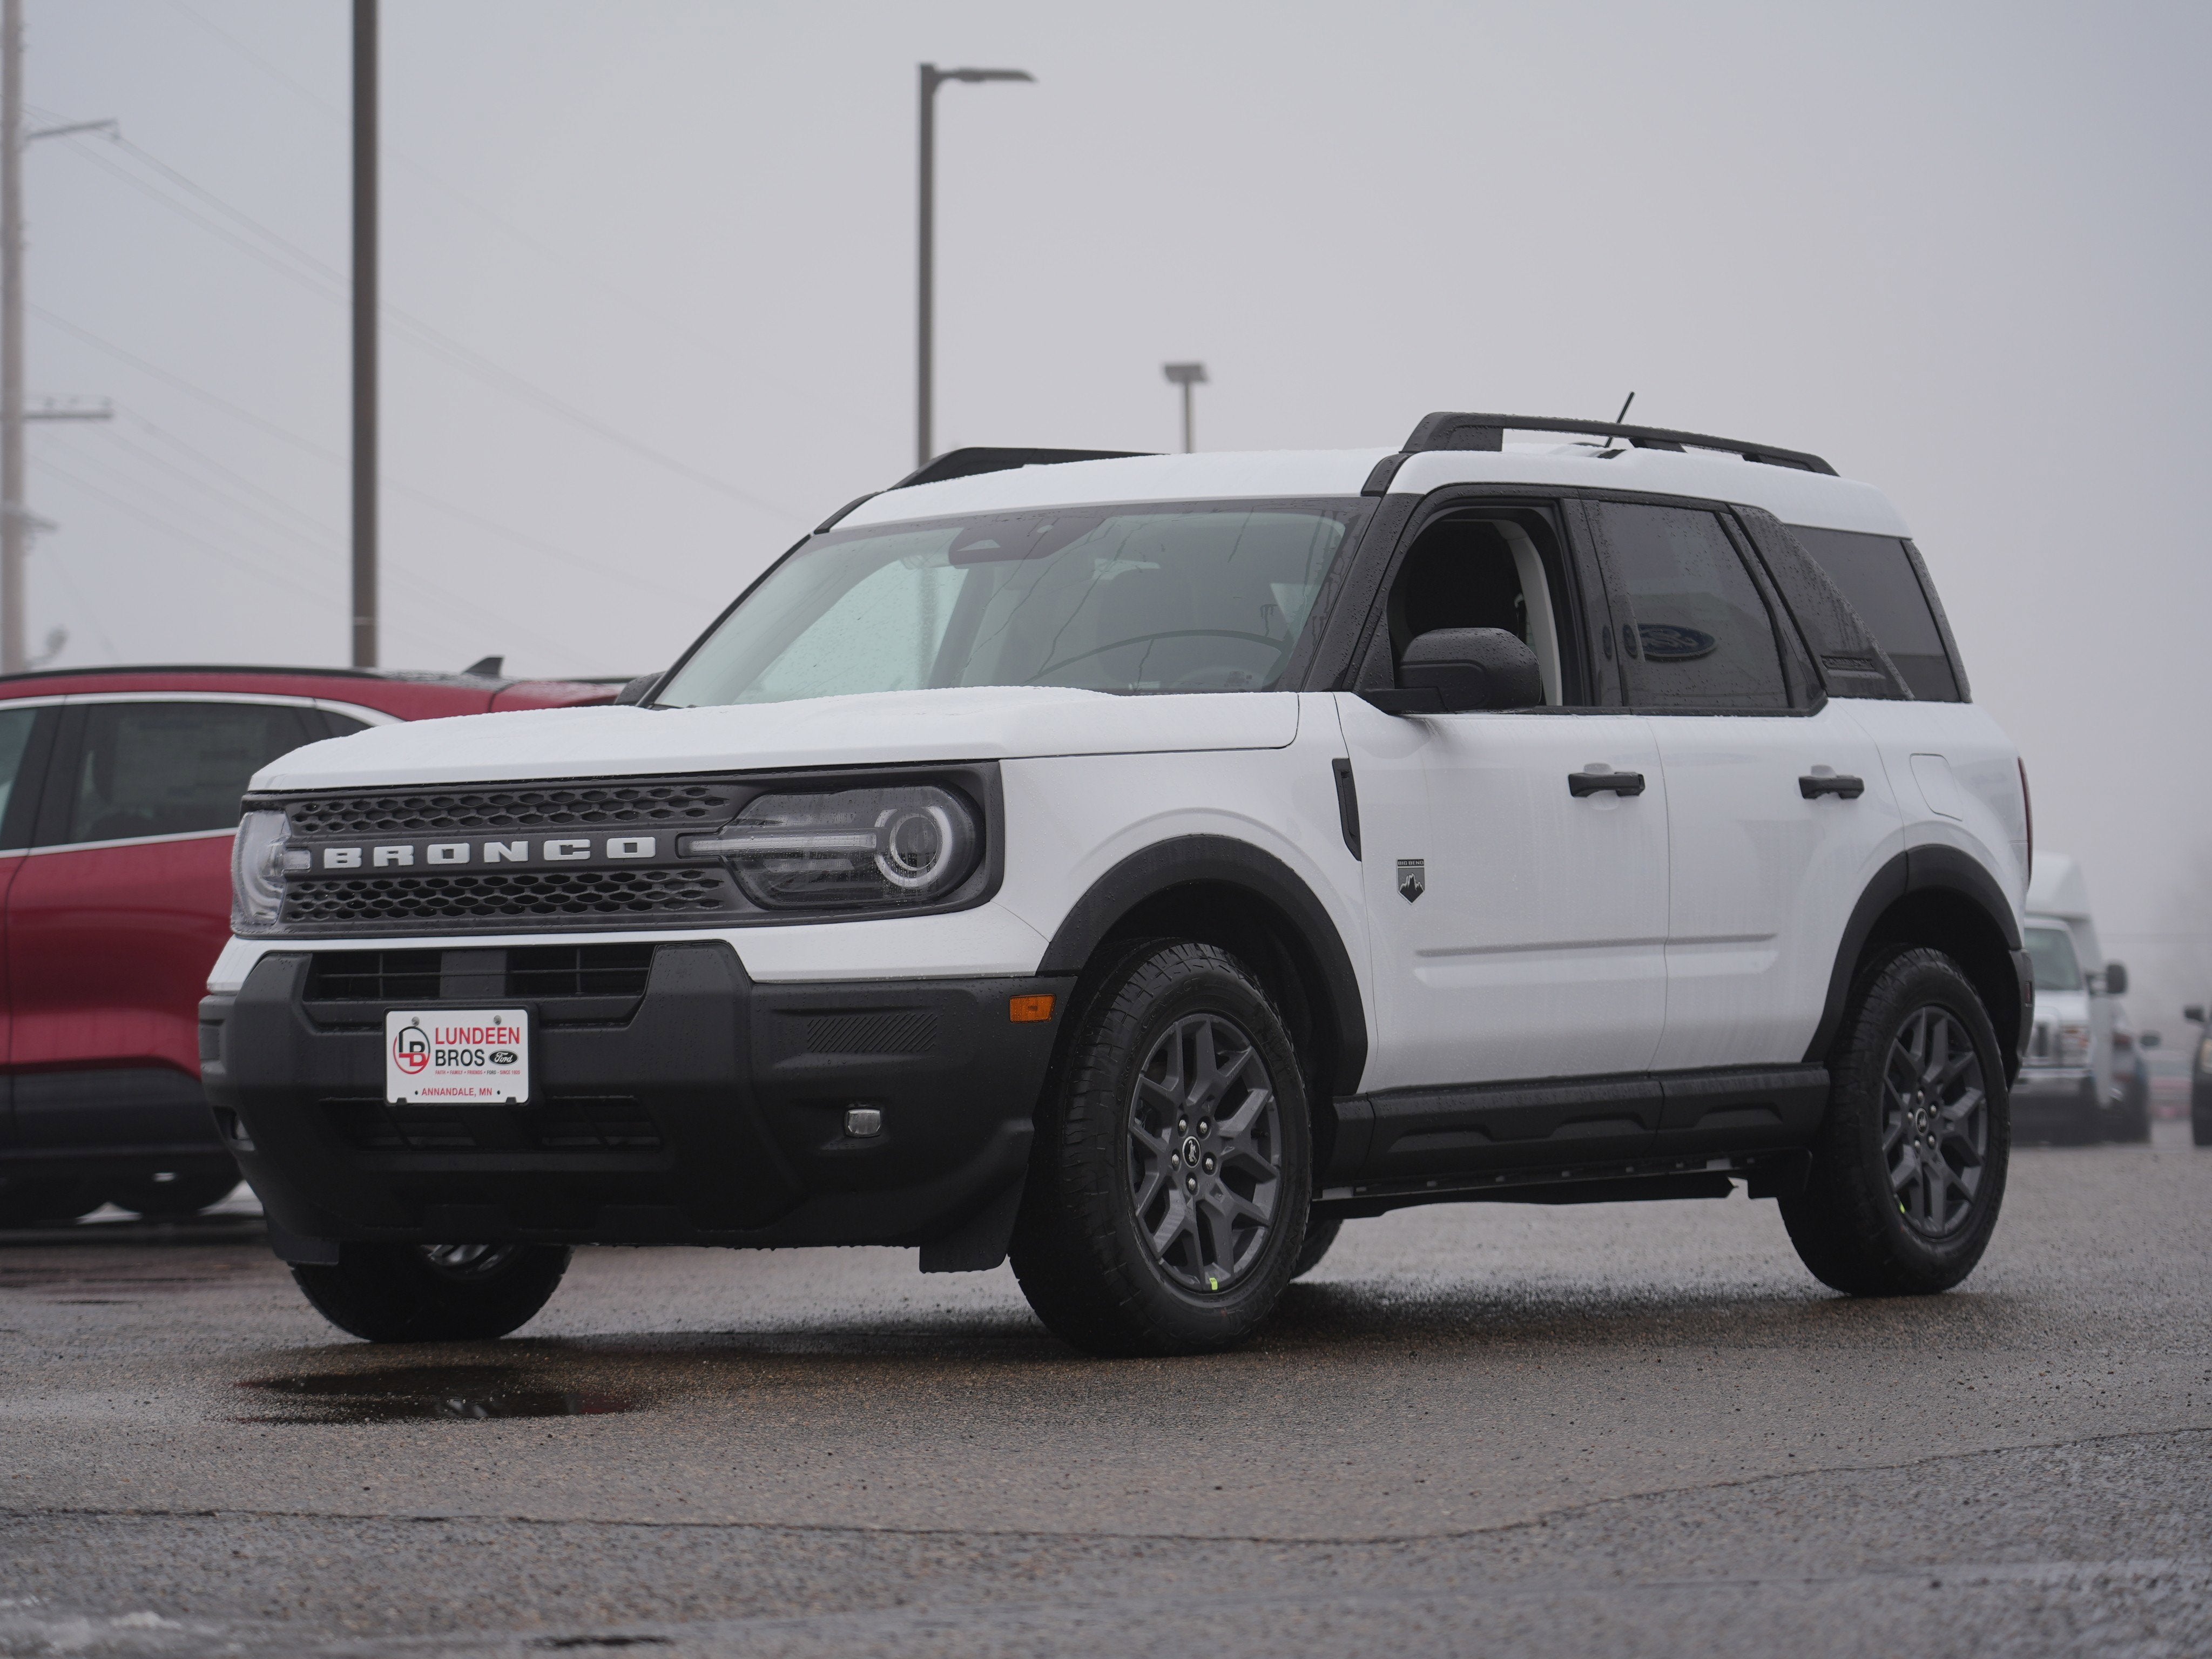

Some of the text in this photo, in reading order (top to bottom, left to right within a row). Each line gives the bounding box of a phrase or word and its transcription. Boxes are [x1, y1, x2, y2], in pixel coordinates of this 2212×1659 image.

[323, 837, 656, 869] BRONCO
[435, 1027, 520, 1044] LUNDEEN
[435, 1049, 485, 1067] BROS
[421, 1088, 493, 1097] ANNANDALE, MN
